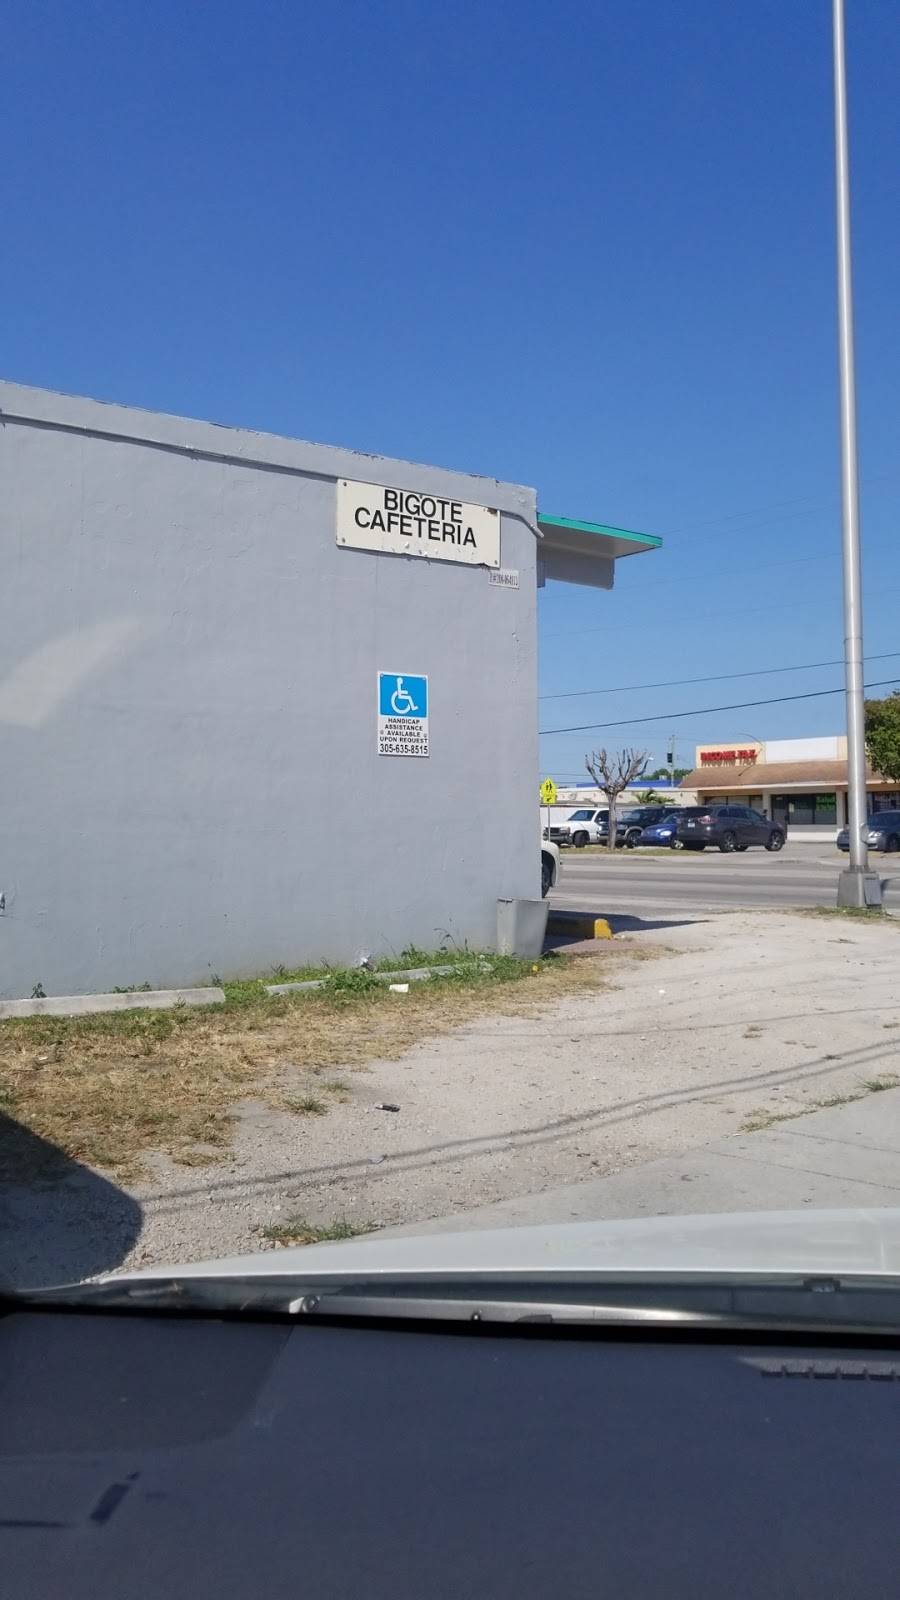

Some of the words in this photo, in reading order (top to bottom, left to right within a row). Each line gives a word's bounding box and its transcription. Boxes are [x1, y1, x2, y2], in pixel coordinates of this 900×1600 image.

[384, 489, 463, 524] BIGOTE
[354, 507, 477, 548] CAFETERIA
[380, 744, 428, 754] 305-635-8515
